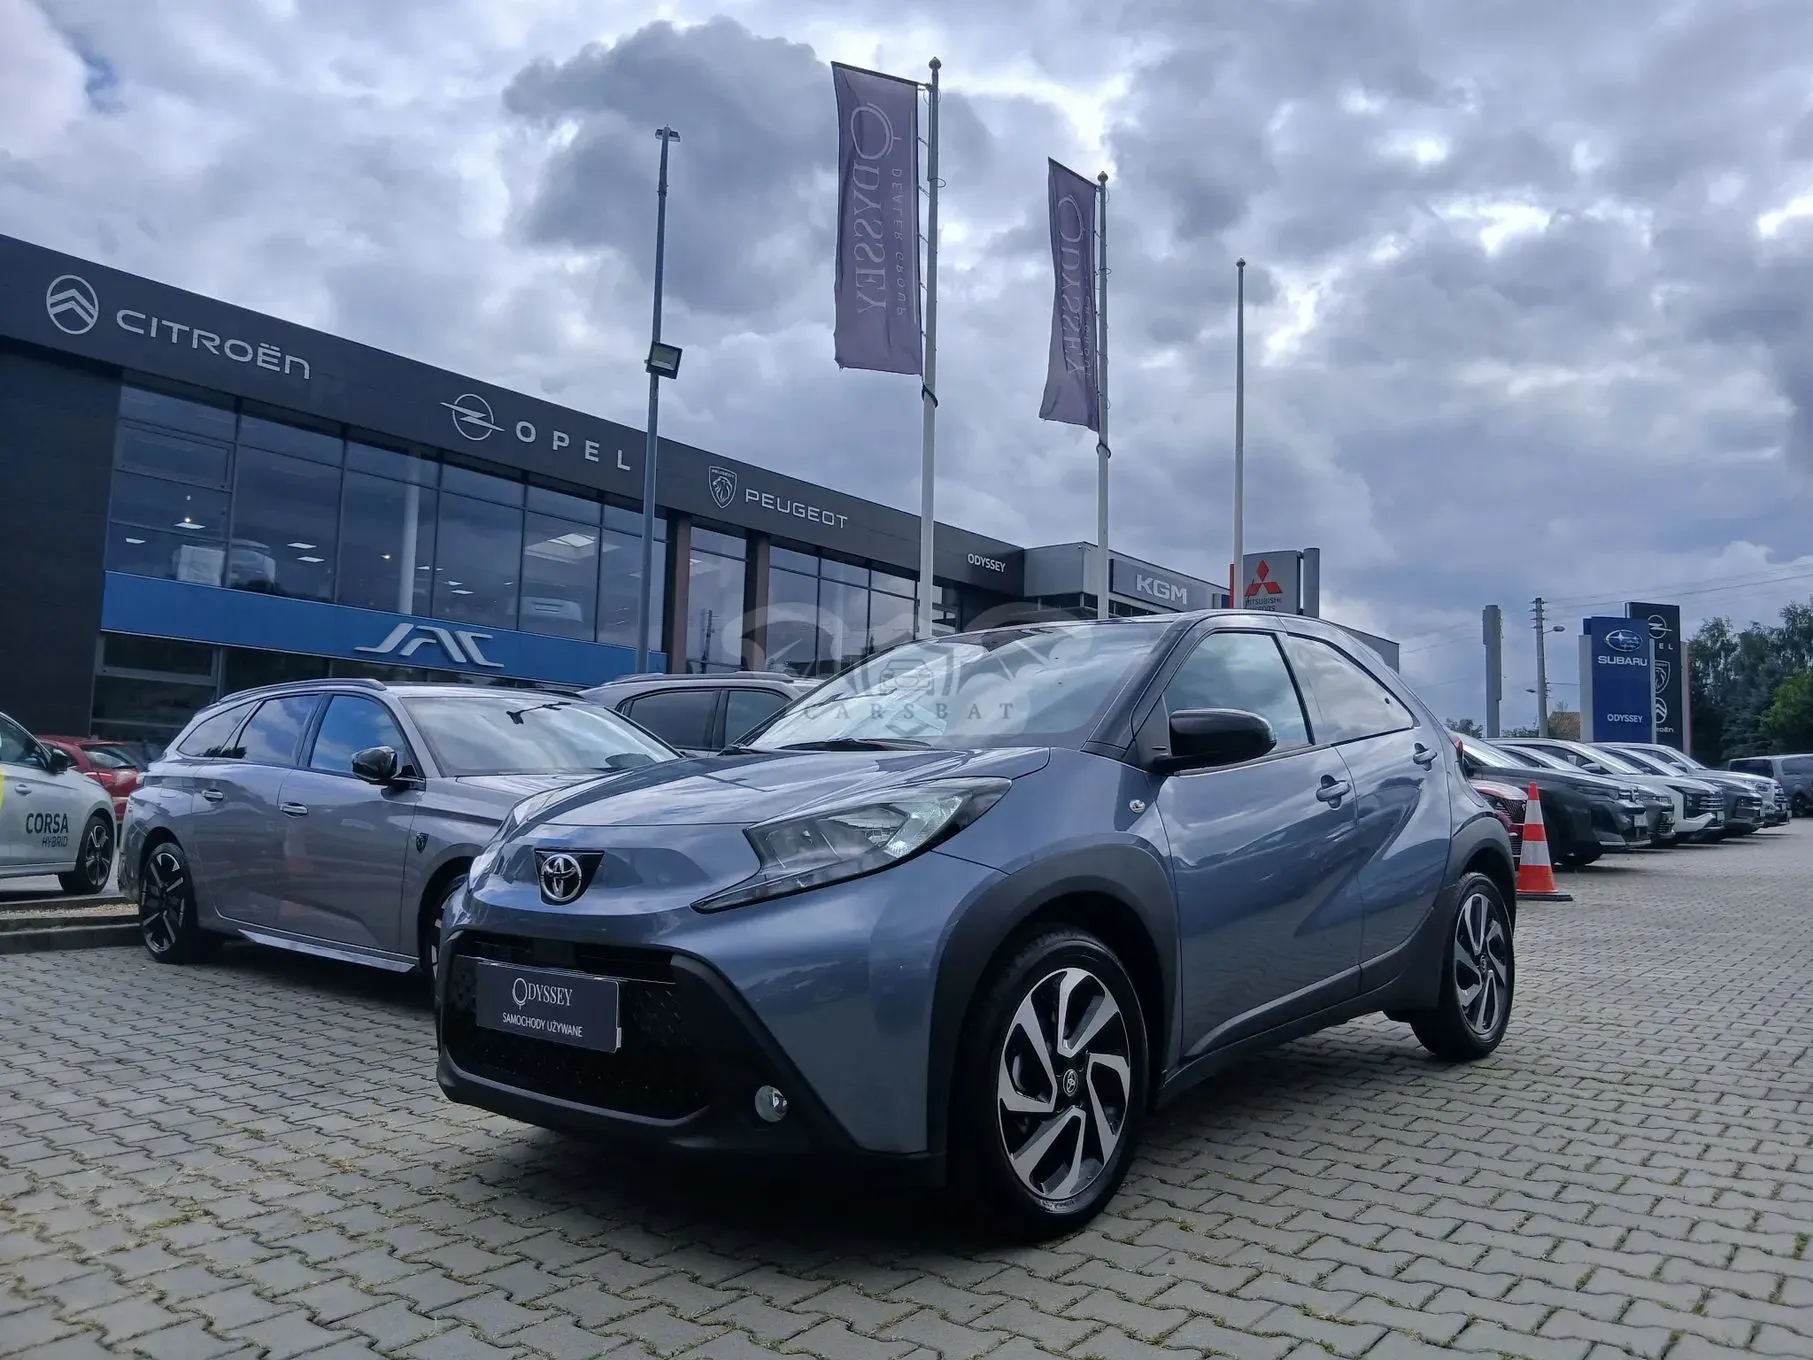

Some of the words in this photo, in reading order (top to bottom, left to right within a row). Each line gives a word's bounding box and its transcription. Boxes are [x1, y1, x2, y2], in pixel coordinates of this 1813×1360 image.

[515, 421, 631, 471] OPEL
[745, 488, 848, 529] PEUGEOT
[967, 553, 1006, 573] ODYSSEY
[1136, 574, 1188, 605] KGM
[353, 622, 505, 668] JAC
[1658, 642, 1673, 650] EL
[1597, 655, 1648, 667] SUBARU
[1607, 713, 1643, 724] ODYSSEY
[25, 813, 69, 834] CORSA
[41, 836, 68, 848] HYBRID
[512, 977, 573, 1010] ODYSSEY
[502, 1012, 546, 1031] SAMOCHODY
[546, 1019, 583, 1038] UŻYWANE
